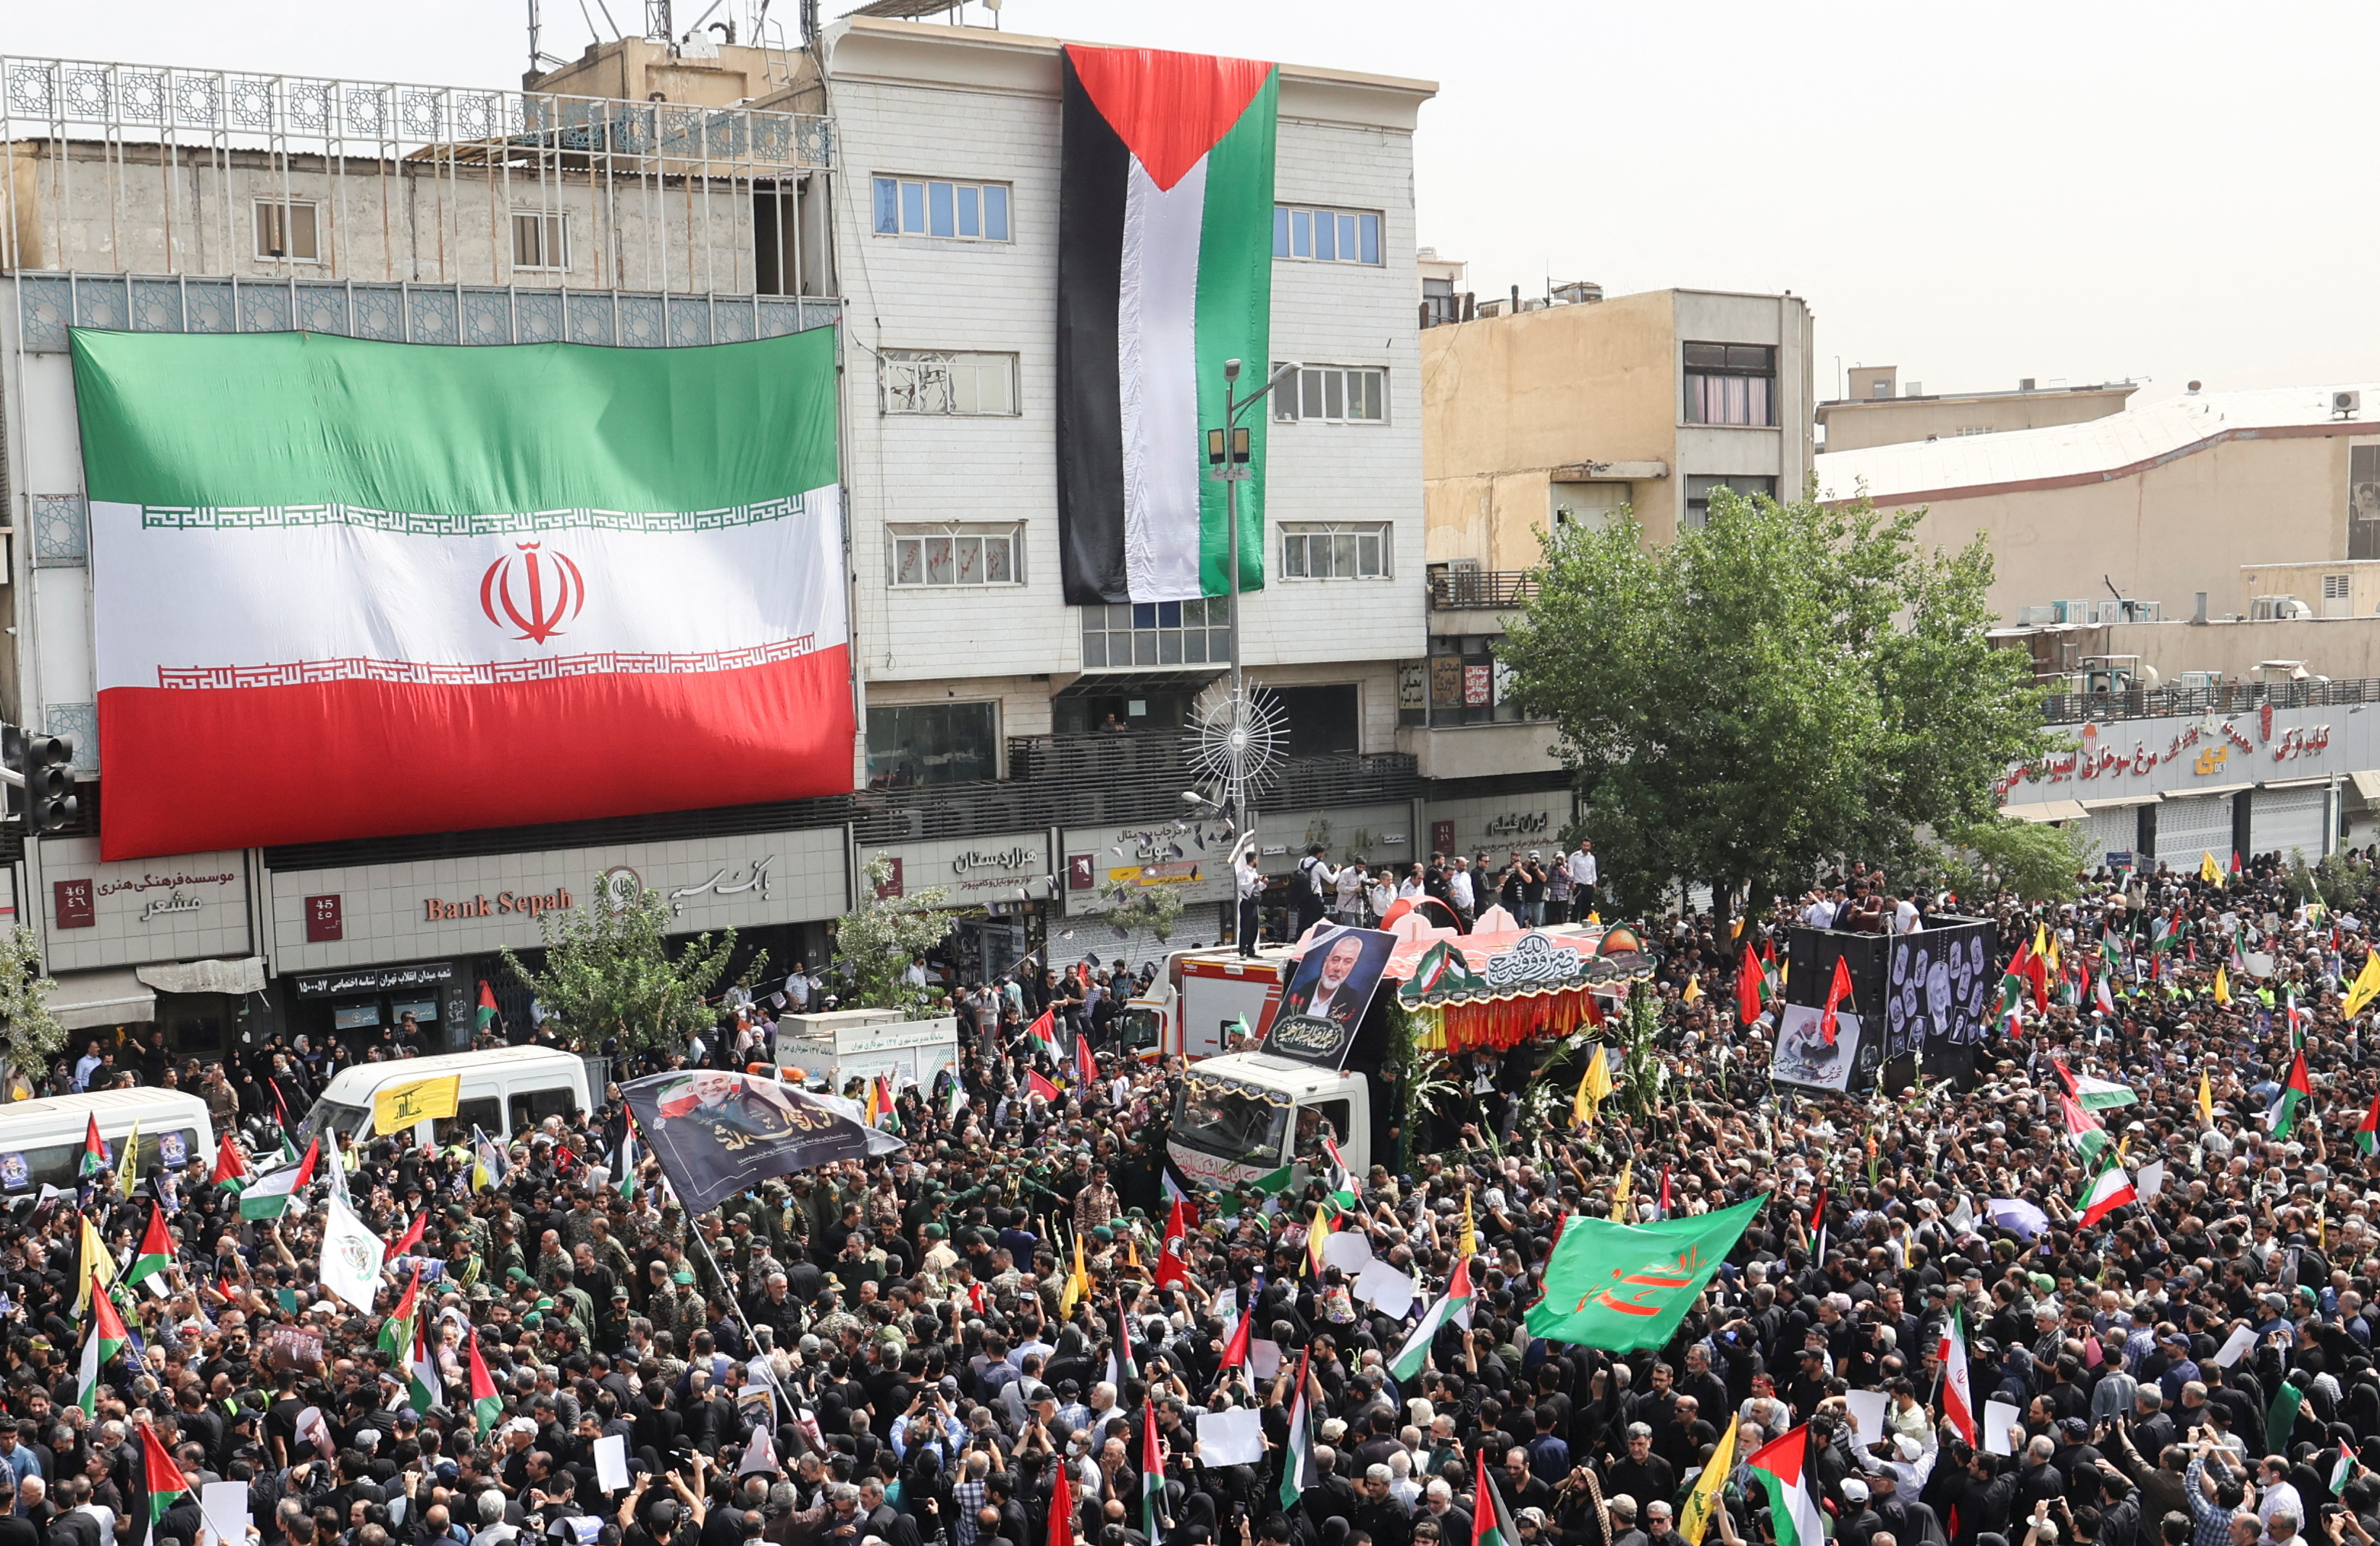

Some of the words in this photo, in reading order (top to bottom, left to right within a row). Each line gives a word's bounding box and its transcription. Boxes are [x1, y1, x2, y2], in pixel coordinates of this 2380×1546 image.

[1465, 668, 1489, 677] صحافی
[1466, 676, 1487, 686] فوری
[1466, 686, 1489, 694] صحافی
[1466, 694, 1488, 703] فوری
[2274, 726, 2303, 760] ترکی
[2305, 724, 2330, 757] کباب
[2081, 744, 2131, 779] سوخاری
[2132, 740, 2158, 776] مرغ
[2214, 762, 2226, 773] DEY
[1491, 813, 1520, 836] فیلم
[1521, 811, 1549, 833] ایران
[1154, 825, 1171, 841] چاپ
[135, 871, 184, 893] فرهنگی
[185, 872, 235, 886] موسسه
[715, 854, 775, 900] بانک
[65, 885, 85, 896] 46
[97, 879, 133, 896] هنری
[671, 868, 726, 916] سپه
[141, 891, 203, 922] مشعر
[316, 899, 333, 909] 45
[425, 894, 494, 921] Bank
[498, 887, 574, 918] Sepah
[359, 975, 375, 986] شناسه
[379, 972, 397, 988] تهران
[396, 970, 417, 983] انقلاب
[417, 970, 436, 984] میدان
[435, 969, 451, 980] شعبه
[330, 977, 358, 992] اختصاصی
[930, 1033, 944, 1041] سامانه
[778, 1042, 790, 1052] تهران
[789, 1045, 809, 1054] شهرداری
[820, 1047, 834, 1056] سامانه
